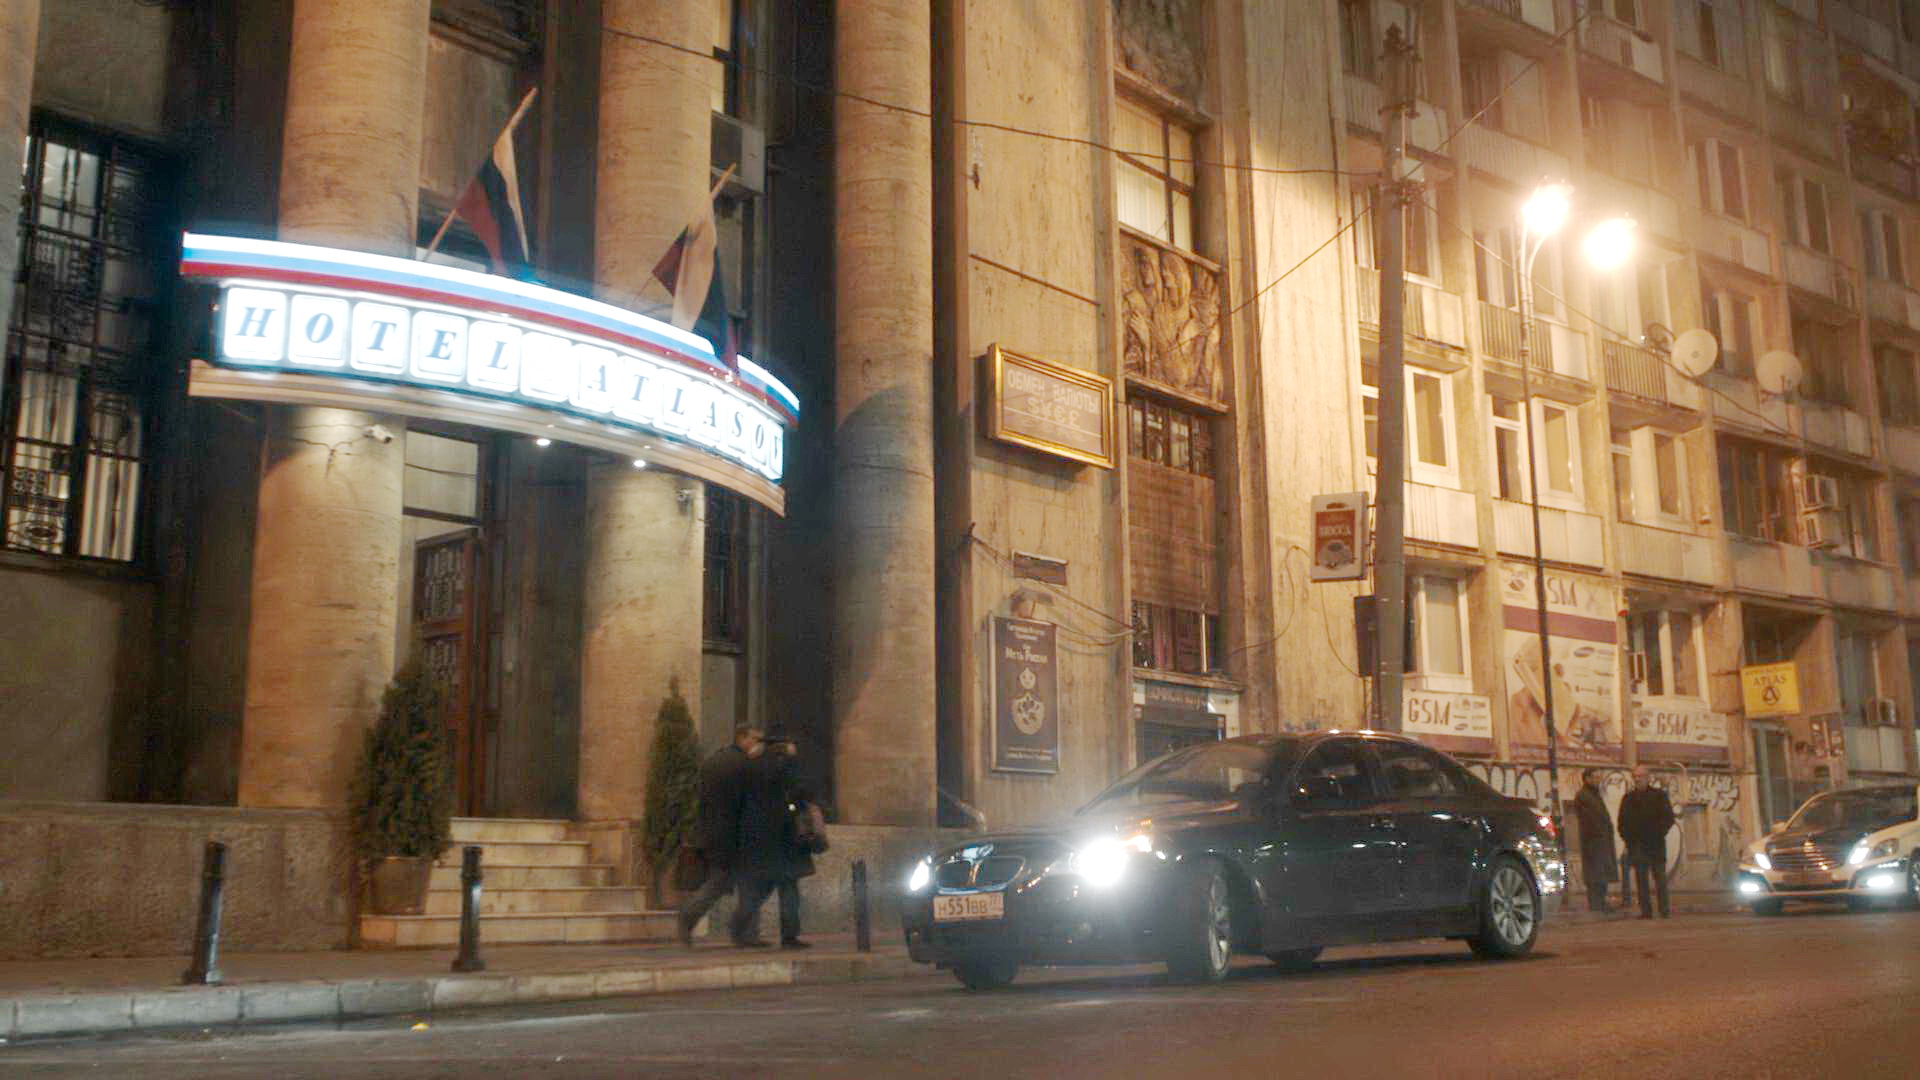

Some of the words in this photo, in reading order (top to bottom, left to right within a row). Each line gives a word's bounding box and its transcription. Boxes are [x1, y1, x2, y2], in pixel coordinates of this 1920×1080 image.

[235, 306, 509, 370] HOTEL
[1408, 698, 1451, 726] GSM
[1656, 712, 1689, 737] GSM
